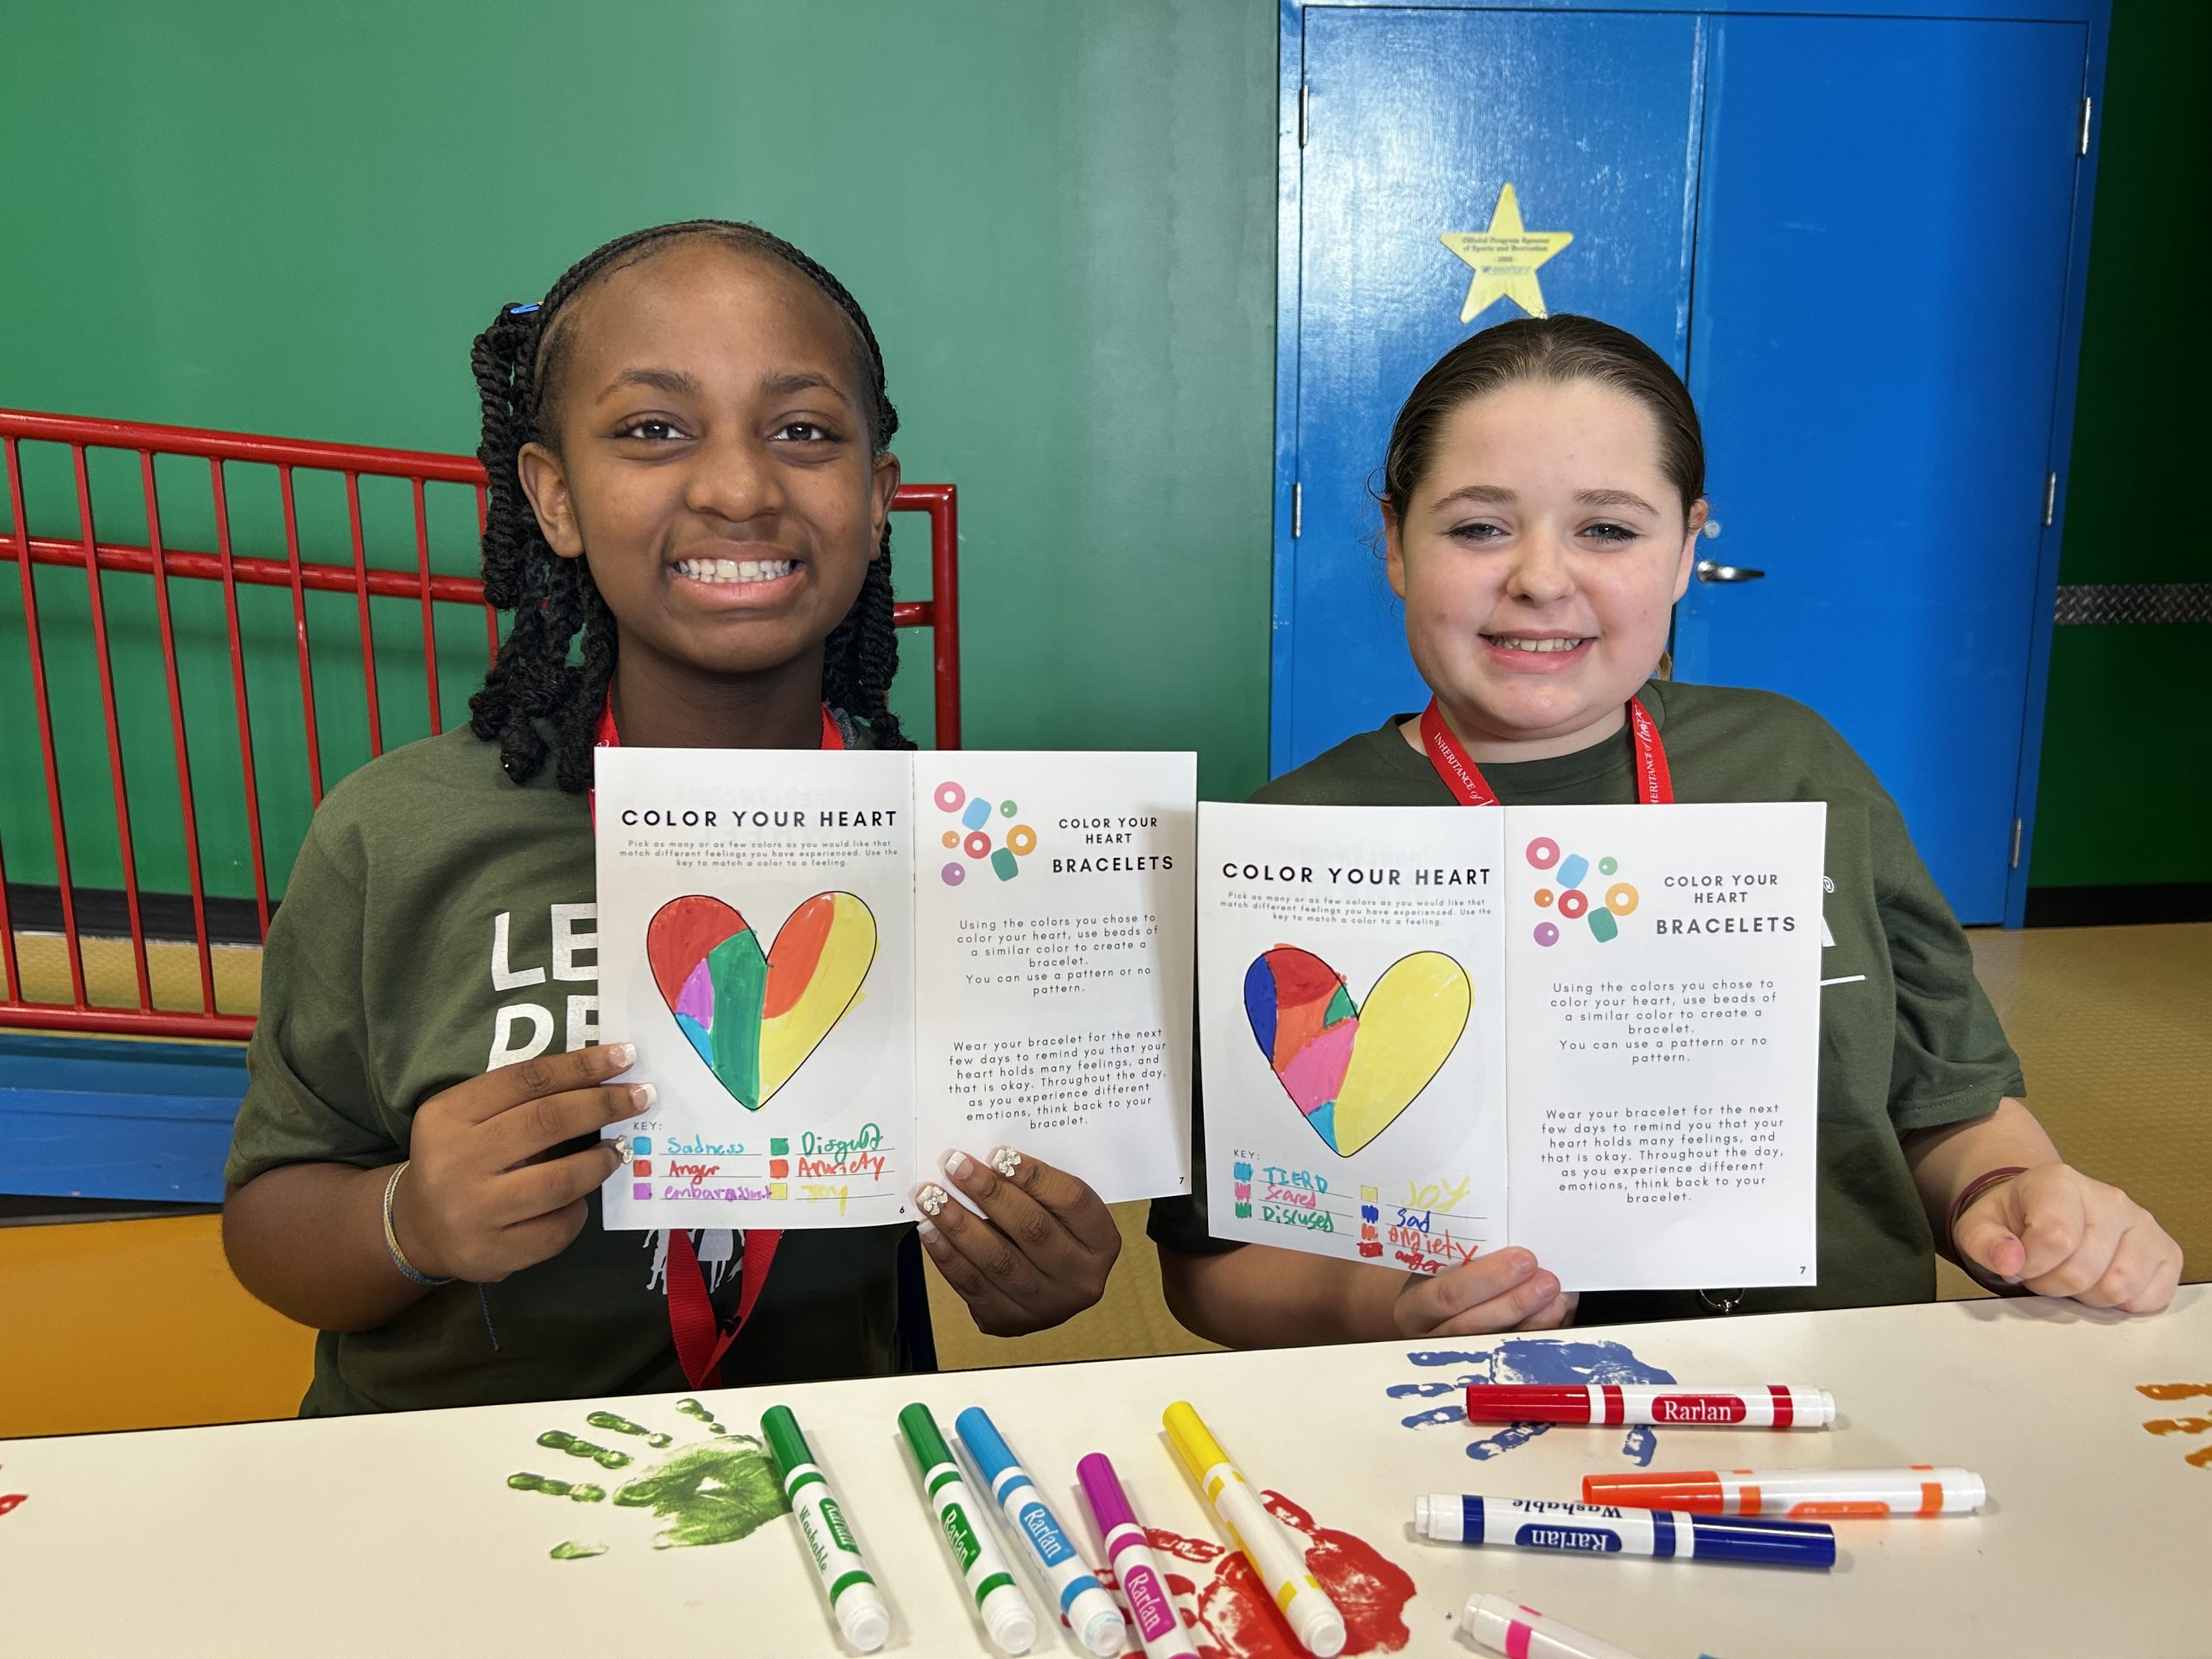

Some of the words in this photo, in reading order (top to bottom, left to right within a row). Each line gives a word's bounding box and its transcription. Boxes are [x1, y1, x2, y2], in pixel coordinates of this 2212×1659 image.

[1433, 732, 1476, 791] INHERITANCE
[621, 810, 716, 827] COLOR
[732, 810, 804, 827] YOUR
[820, 810, 896, 827] HEART
[1058, 817, 1110, 829] COLOR
[1117, 817, 1157, 828] YOUR
[1085, 833, 1132, 844] HEART
[1052, 855, 1173, 873] BRACELETS
[1223, 862, 1313, 883] COLOR
[1328, 868, 1402, 886] YOUR
[1415, 868, 1491, 886] HEART
[1663, 875, 1723, 887] COLOR
[1732, 874, 1777, 886] YOUR
[1694, 891, 1748, 904] HEART
[959, 919, 996, 931] Using
[1002, 917, 1024, 928] the
[1030, 915, 1070, 927] colors
[1075, 917, 1096, 928] you
[1103, 913, 1138, 925] chose
[1143, 913, 1158, 924] to
[1656, 916, 1795, 935] BRACELETS
[957, 932, 992, 944] color
[998, 933, 1027, 945] your
[1033, 930, 1071, 941] heart,
[1077, 930, 1098, 938] use
[1103, 925, 1141, 938] beads
[1146, 923, 1160, 935] of
[984, 944, 1030, 957] similar
[1035, 942, 1069, 954] color
[1074, 943, 1087, 952] to
[1092, 940, 1134, 951] create
[1028, 955, 1088, 968] bracelet.
[965, 974, 990, 984] You
[997, 975, 1020, 983] can
[1027, 973, 1048, 982] use
[1067, 969, 1114, 982] pattern
[1119, 968, 1132, 976] or
[1033, 984, 1084, 997] pattern.
[1553, 982, 1592, 995] Using
[1599, 981, 1623, 993] the
[1630, 980, 1675, 992] colors
[1681, 982, 1705, 994] you
[1712, 977, 1753, 990] chose
[1759, 979, 1774, 988] to
[1549, 995, 1588, 1007] color
[1594, 998, 1625, 1010] your
[1632, 995, 1675, 1007] heart,
[1682, 996, 1706, 1005] use
[1713, 991, 1756, 1004] beads
[1762, 991, 1777, 1002] of
[1580, 1009, 1630, 1021] similar
[1635, 1007, 1673, 1020] color
[1679, 1009, 1694, 1019] to
[1700, 1007, 1747, 1019] create
[1627, 1022, 1694, 1035] bracelet.
[953, 1040, 987, 1052] Wear
[993, 1040, 1021, 1052] your
[1027, 1033, 1082, 1047] bracelet
[1088, 1032, 1105, 1042] for
[1111, 1030, 1130, 1040] the
[1136, 1027, 1162, 1039] next
[1559, 1039, 1586, 1050] You
[1592, 1041, 1618, 1050] can
[1624, 1040, 1649, 1049] use
[1670, 1037, 1724, 1051] pattern
[1730, 1038, 1745, 1046] or
[1751, 1037, 1767, 1046] no
[949, 1054, 973, 1065] few
[980, 1052, 1010, 1066] days
[1016, 1052, 1029, 1062] to
[1035, 1046, 1077, 1060] remind
[1084, 1047, 1104, 1059] you
[1109, 1043, 1135, 1054] that
[1141, 1042, 1168, 1054] your
[1631, 1052, 1690, 1065] pattern.
[957, 1068, 993, 1079] heart
[1000, 1064, 1034, 1077] holds
[1039, 1064, 1071, 1074] many
[1077, 1058, 1132, 1070] feelings,
[1137, 1052, 1160, 1065] and
[948, 1083, 976, 1094] that
[983, 1083, 994, 1092] is
[1001, 1079, 1034, 1091] okay.
[1040, 1072, 1110, 1087] Throughout
[1116, 1070, 1135, 1080] the
[989, 1096, 1012, 1109] you
[1018, 1090, 1088, 1105] experience
[1094, 1082, 1149, 1096] different
[966, 1109, 1031, 1122] emotions,
[1036, 1102, 1067, 1115] think
[1073, 1098, 1103, 1111] back
[1108, 1099, 1120, 1108] to
[1125, 1096, 1152, 1109] your
[633, 1122, 663, 1131] KEY:
[1029, 1115, 1087, 1129] bracelet.
[668, 1134, 744, 1154] Sadness
[1234, 1149, 1261, 1161] KEY:
[1179, 1176, 1185, 1185] 7
[1262, 1166, 1328, 1193] TIERD
[899, 1205, 905, 1214] 6
[1800, 1266, 1806, 1274] 7
[1663, 1401, 1732, 1421] Rarlan
[1512, 1499, 1622, 1519] Washable
[799, 1504, 829, 1575] Washable
[943, 1509, 969, 1570] Rarlan
[1024, 1508, 1062, 1559] Rarlan
[1531, 1529, 1609, 1552] Rarlan
[1128, 1572, 1160, 1633] Rarlan
